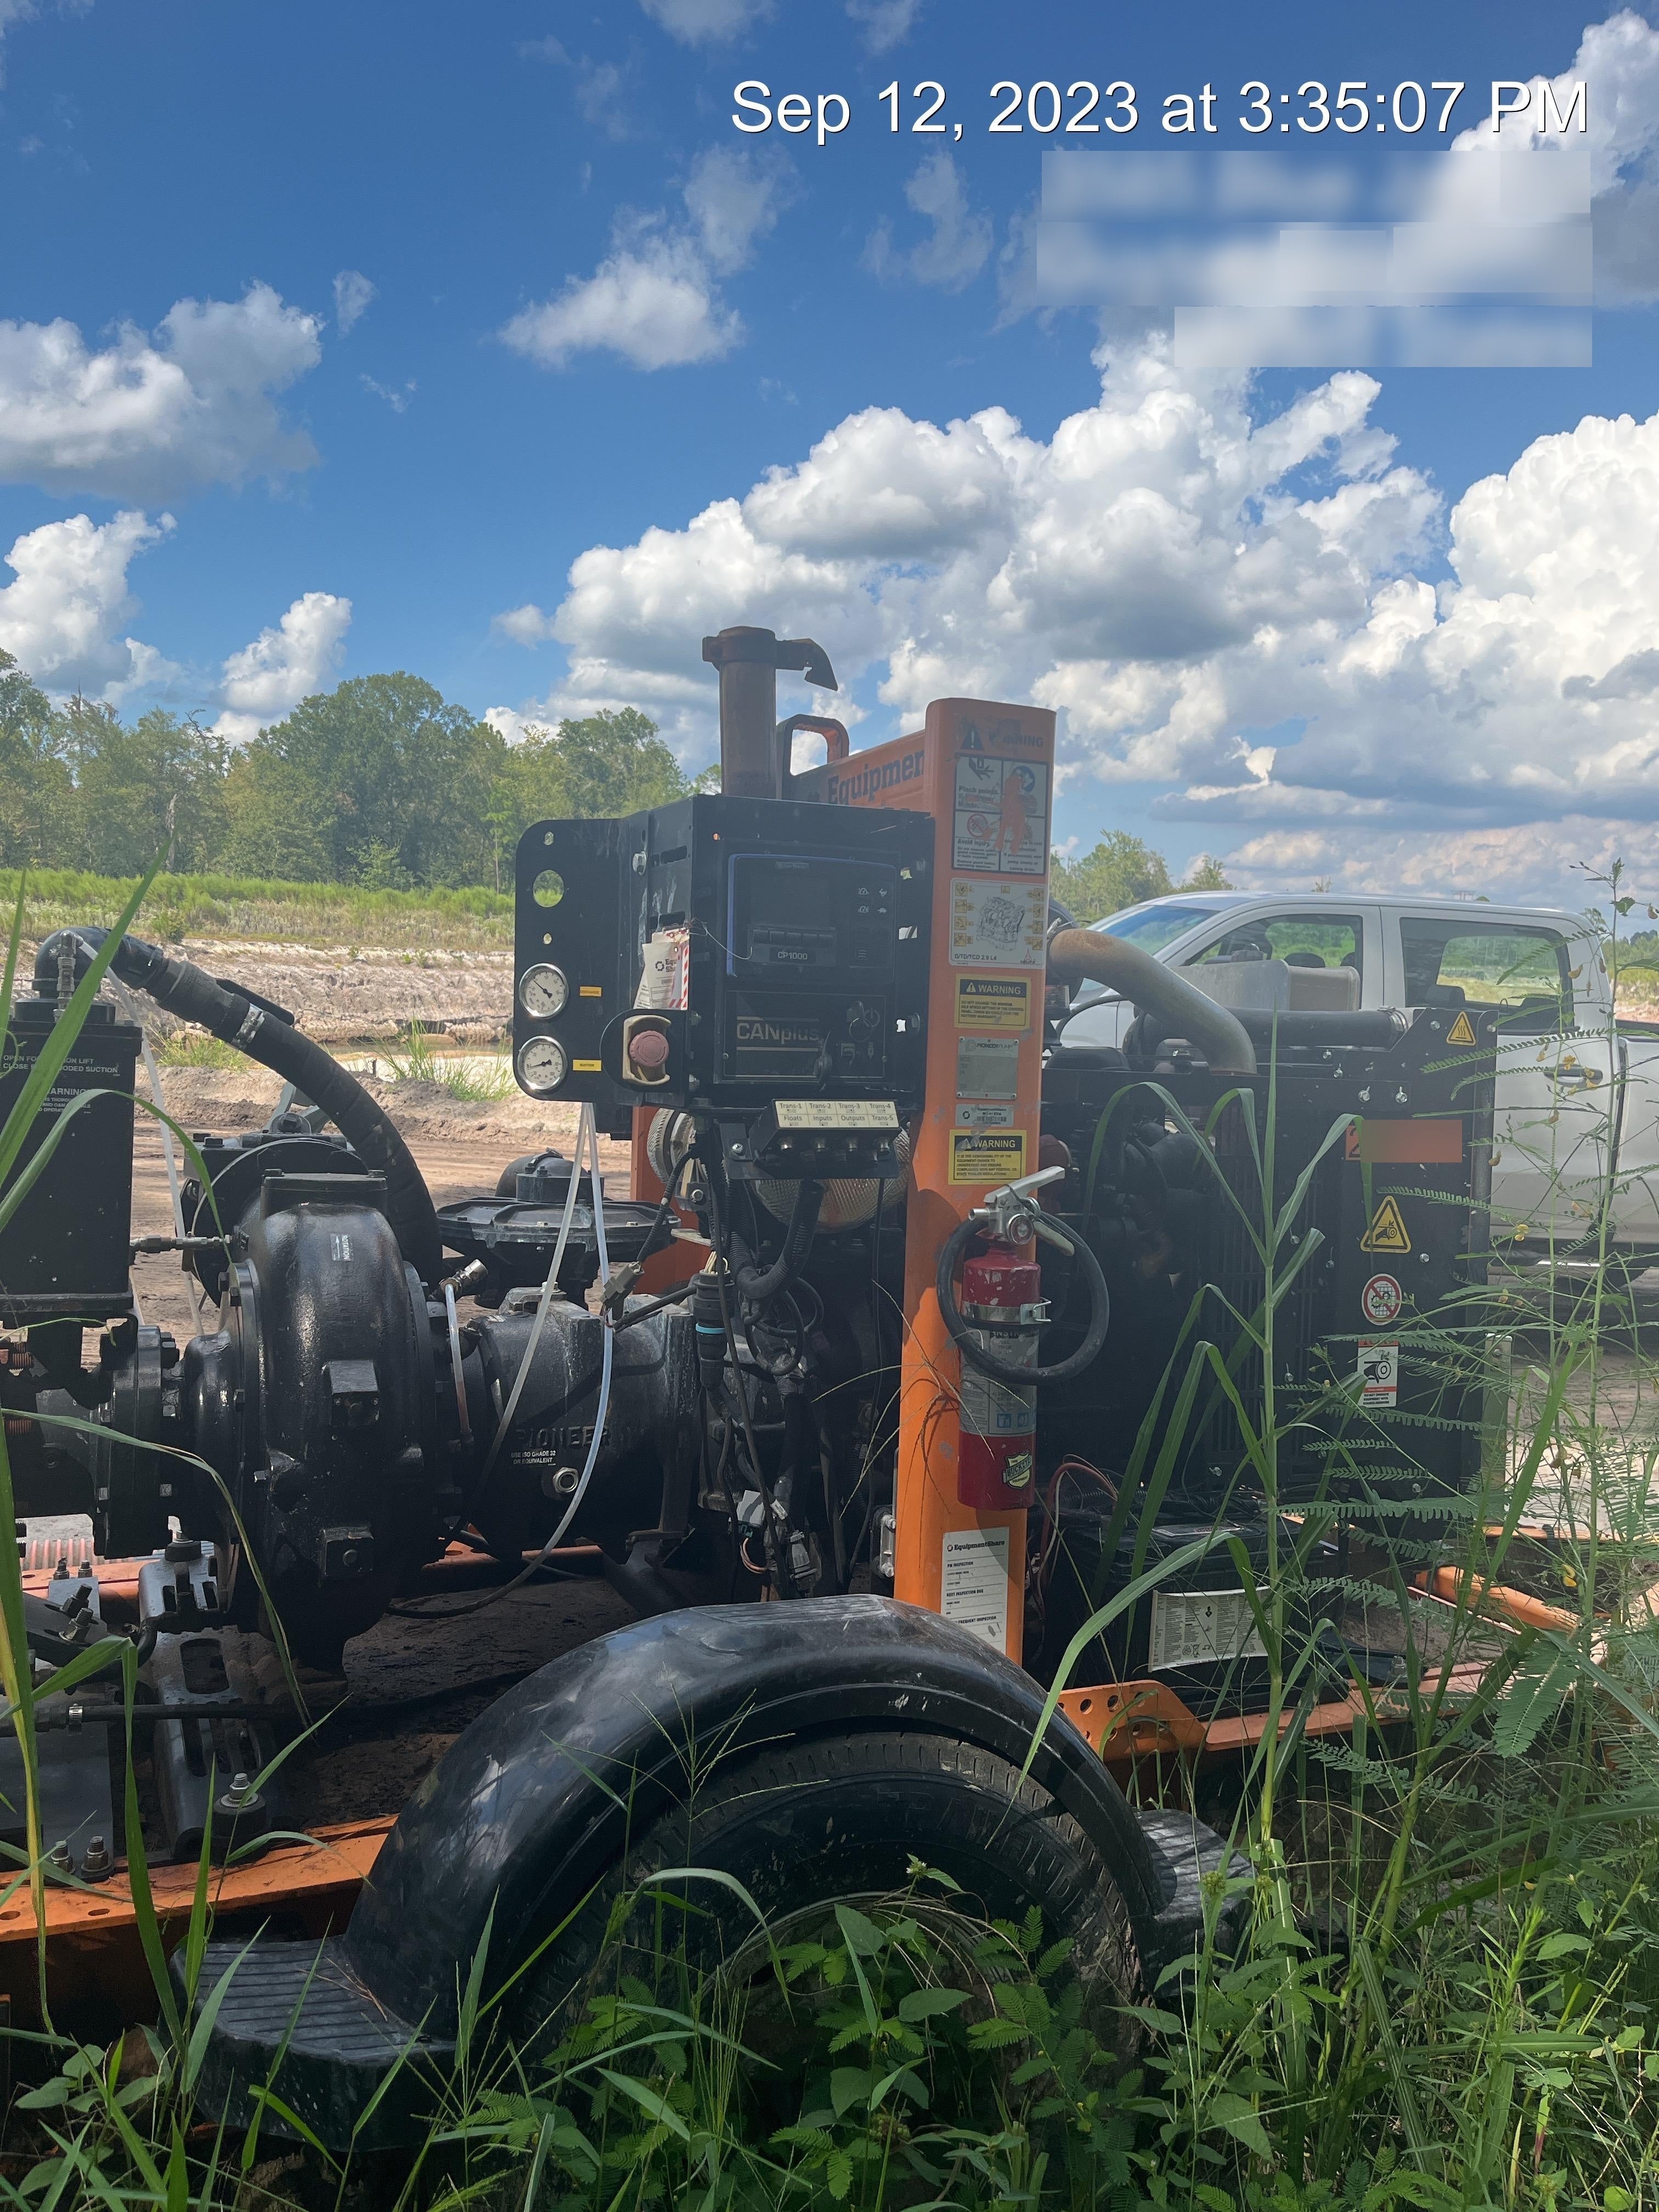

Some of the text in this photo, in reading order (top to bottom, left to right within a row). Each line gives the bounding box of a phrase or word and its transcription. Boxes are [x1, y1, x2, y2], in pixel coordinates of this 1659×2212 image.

[777, 951, 808, 960] CP1000
[978, 984, 1020, 994] WARNING
[737, 1022, 819, 1045] CANplus
[974, 1139, 1015, 1148] WARNING
[954, 1541, 1005, 1551] EquipmentShare
